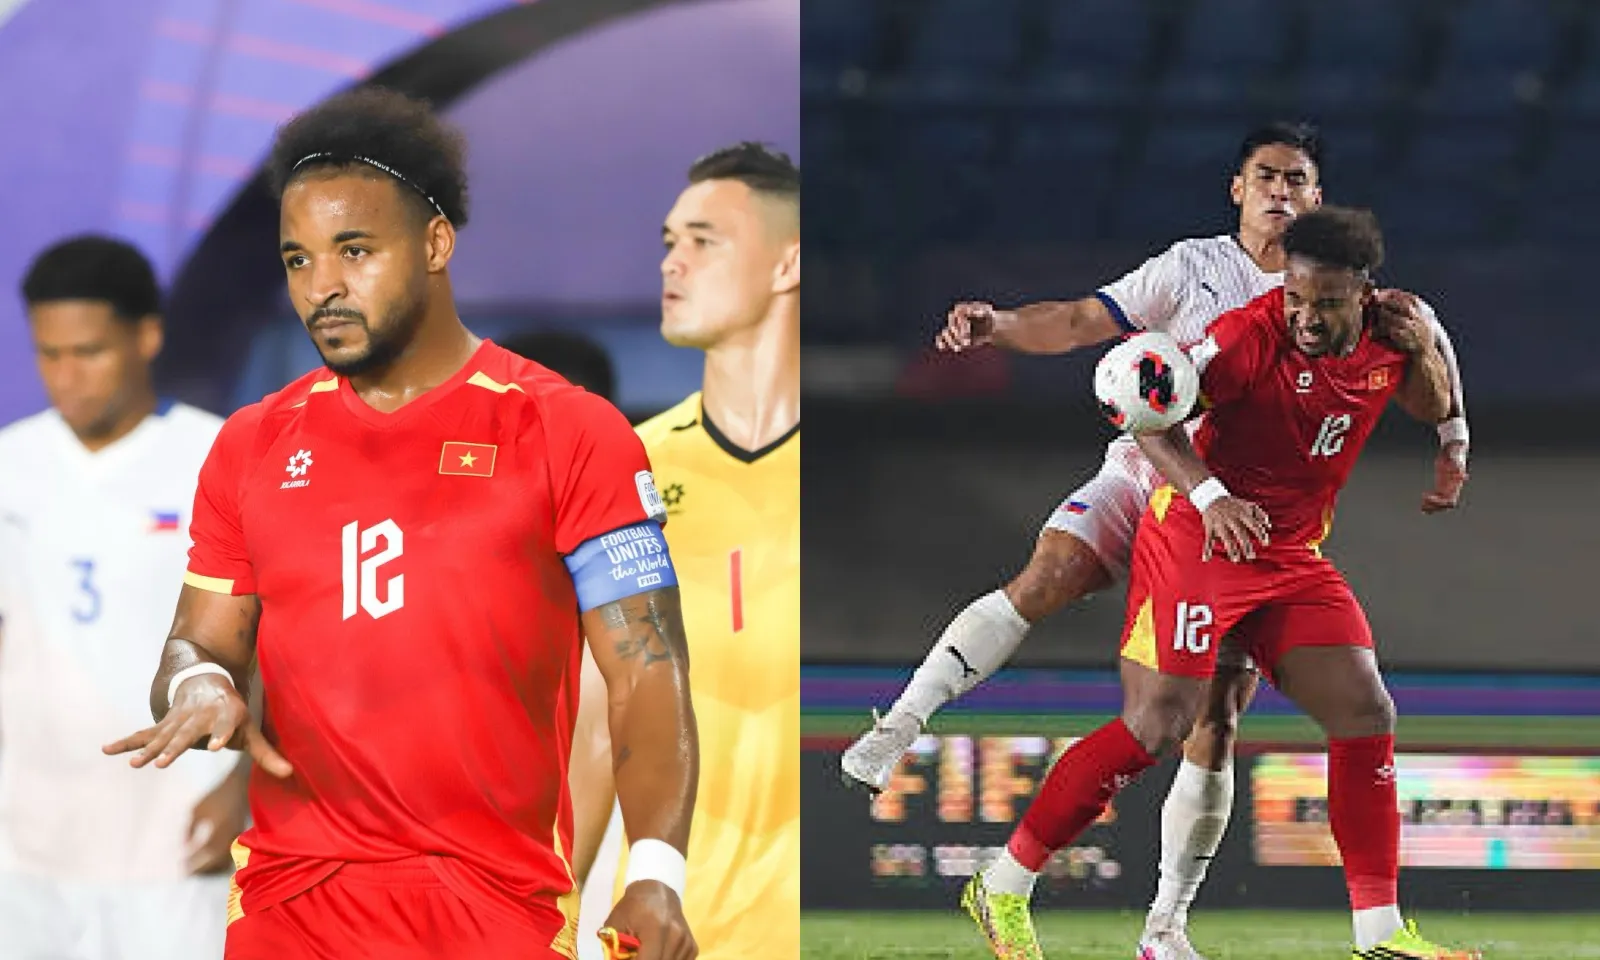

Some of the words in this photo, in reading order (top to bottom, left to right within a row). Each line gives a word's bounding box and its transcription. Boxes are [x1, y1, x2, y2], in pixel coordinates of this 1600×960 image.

[363, 156, 390, 172] MARQUE
[1310, 413, 1351, 456] 12
[601, 526, 654, 549] FOOTBALL
[606, 537, 662, 565] UNITES
[341, 517, 405, 622] 12
[608, 565, 637, 581] the
[636, 554, 670, 573] World
[639, 573, 661, 587] FIFA
[69, 558, 103, 625] 3
[730, 550, 744, 633] 1
[1173, 601, 1213, 654] 12
